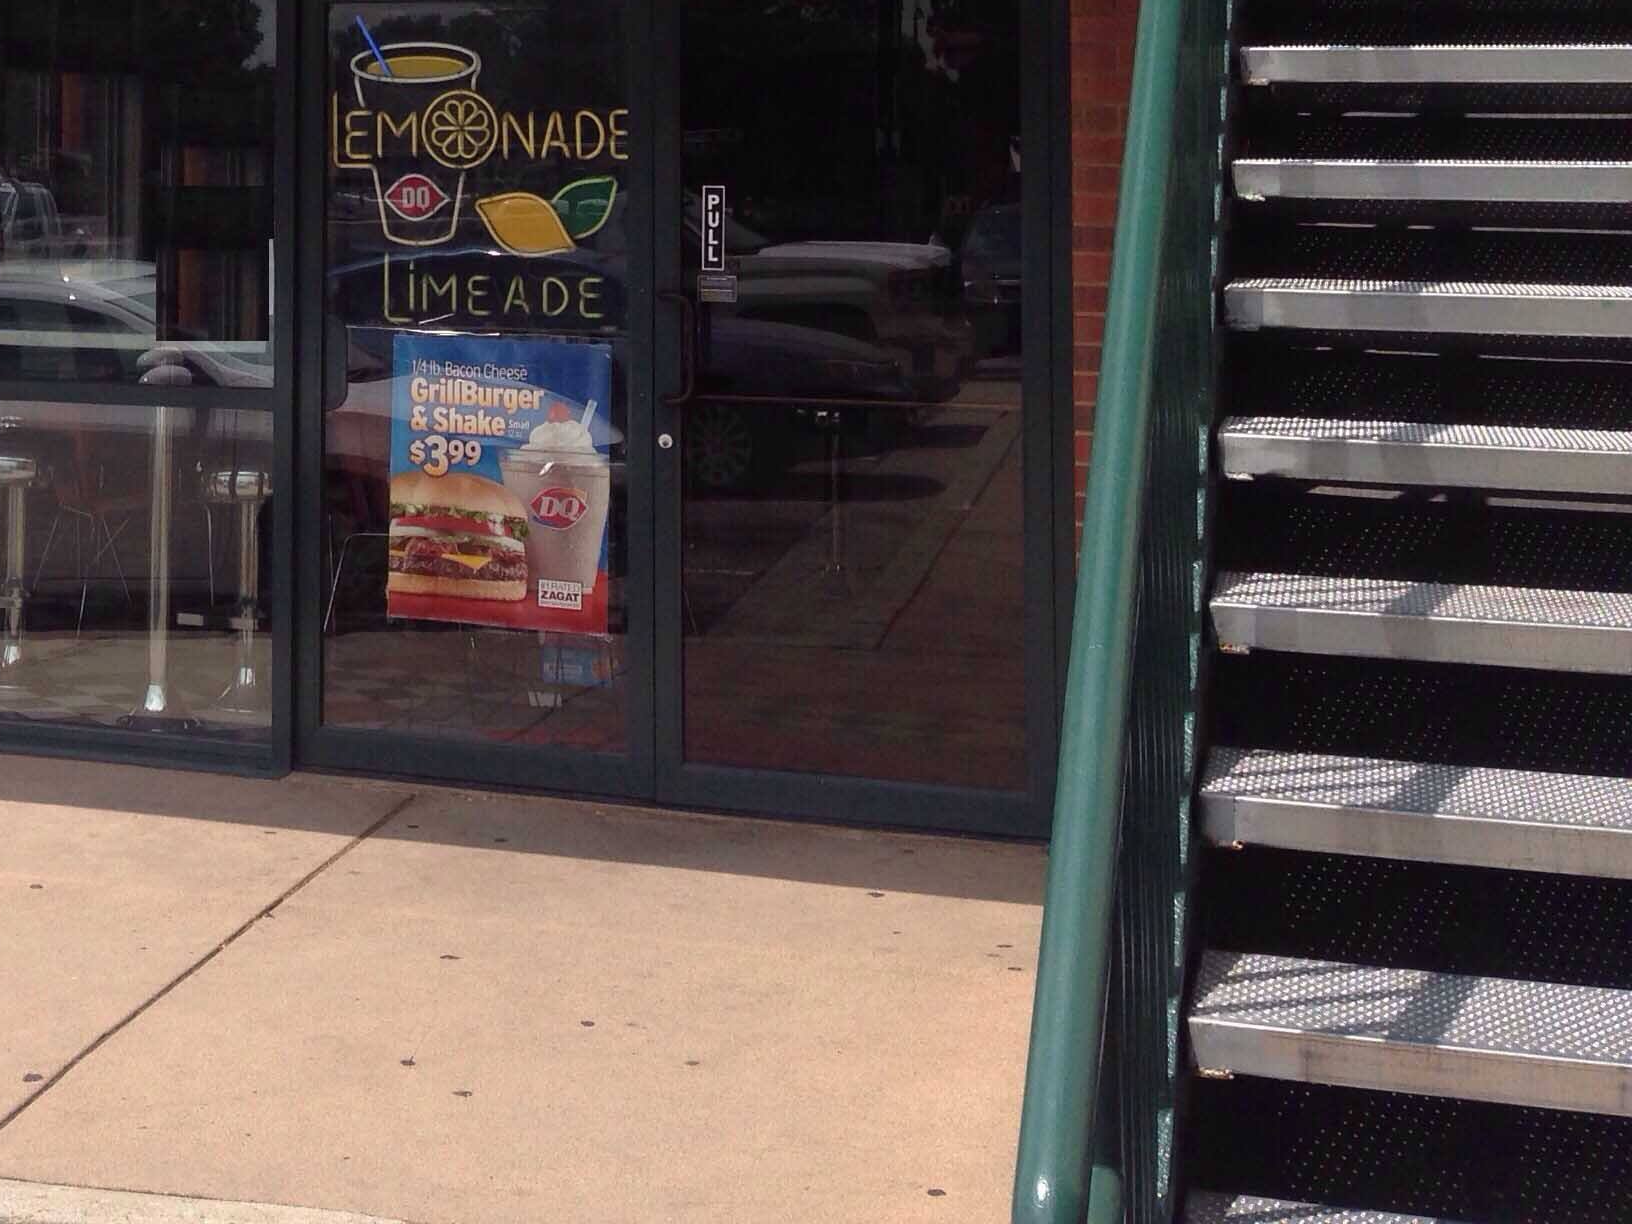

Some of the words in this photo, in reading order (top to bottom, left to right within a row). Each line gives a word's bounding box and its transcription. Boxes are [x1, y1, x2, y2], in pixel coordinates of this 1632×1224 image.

[332, 89, 630, 169] LEMONADE
[401, 185, 431, 212] DQ
[707, 194, 721, 262] PULL
[411, 358, 427, 376] 1/4
[445, 360, 481, 378] Bacon
[483, 363, 528, 381] Cheese
[410, 377, 545, 413] GrillBurger
[409, 405, 428, 432] &
[432, 406, 507, 436] Shake
[539, 495, 581, 522] DQ
[540, 591, 580, 603] ZAGAT
